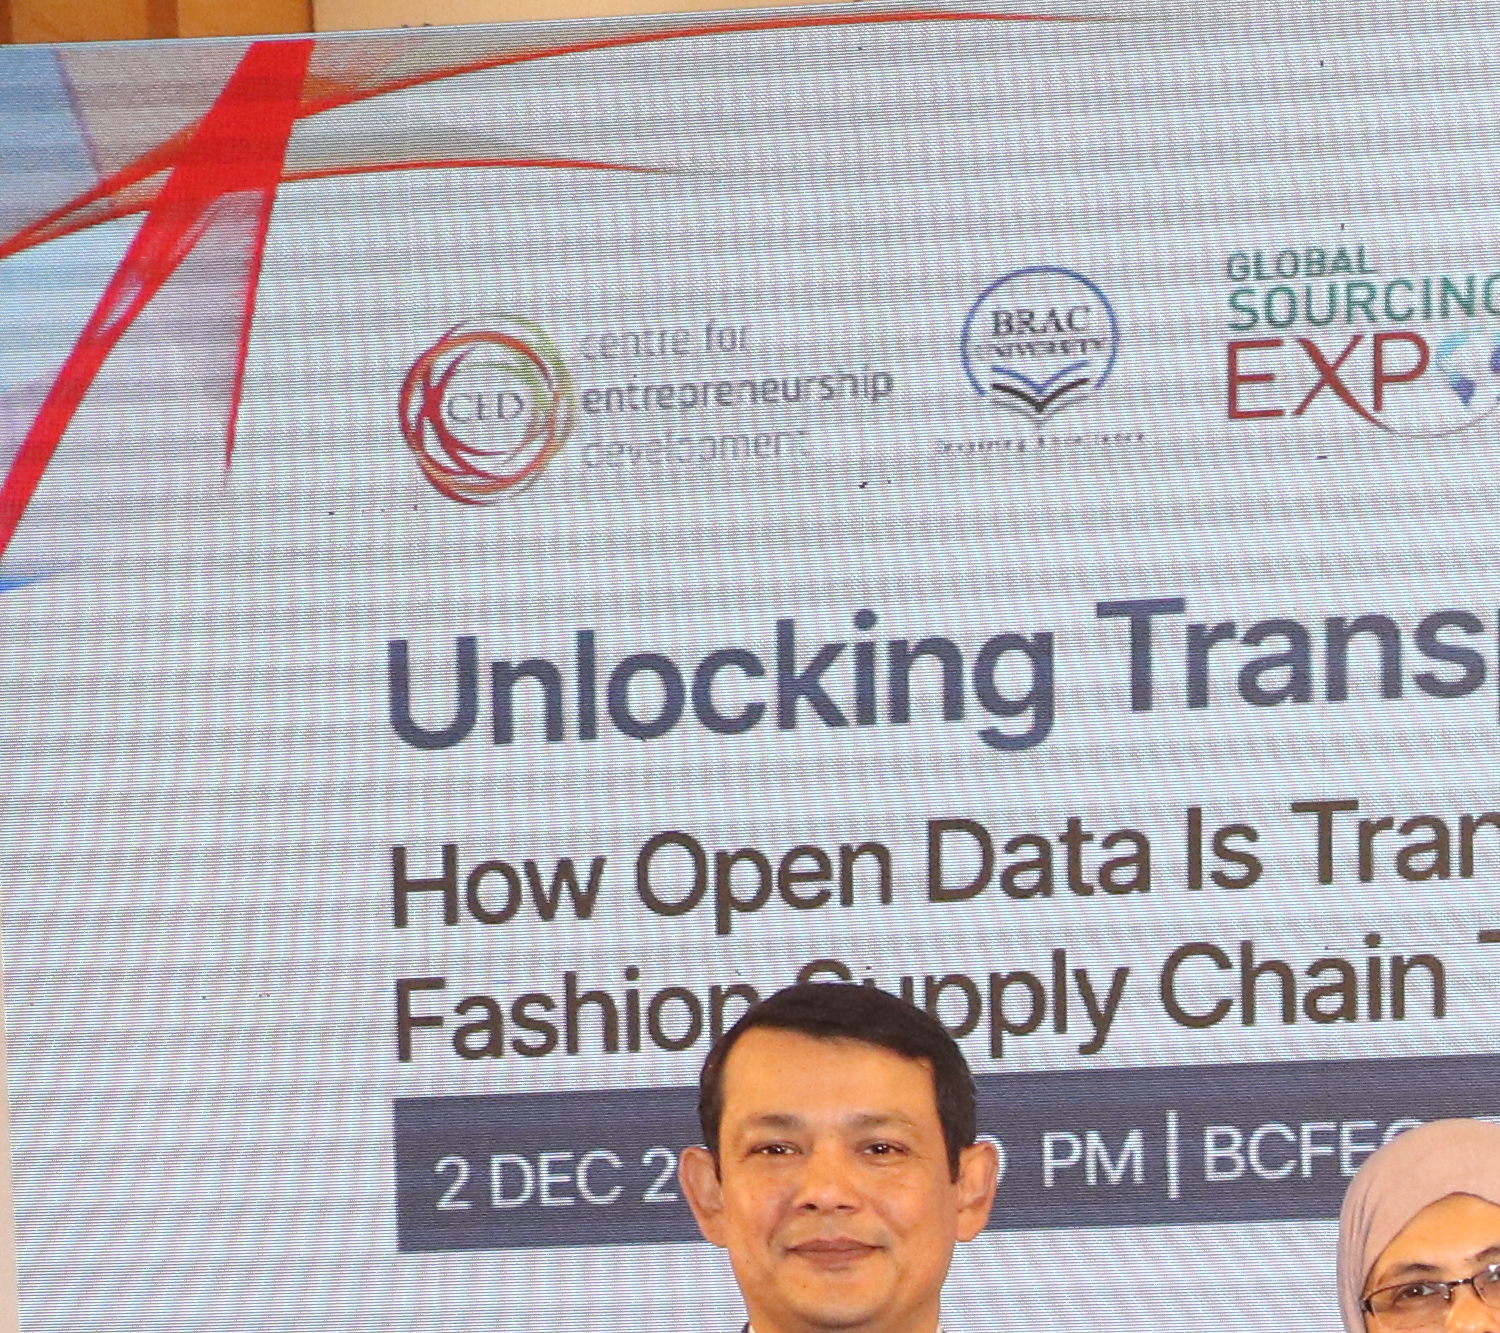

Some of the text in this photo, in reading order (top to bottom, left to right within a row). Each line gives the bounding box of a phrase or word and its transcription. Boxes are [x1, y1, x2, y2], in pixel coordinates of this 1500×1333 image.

[1227, 246, 1379, 281] GLOBAL
[580, 319, 751, 361] centre for
[991, 305, 1091, 336] BRAC
[582, 368, 894, 416] entrepreneurship
[580, 430, 805, 470] development
[386, 608, 1056, 751] Unlocking
[391, 842, 605, 929] How
[635, 829, 893, 937] Open
[926, 816, 1152, 905] Data
[1186, 806, 1263, 891] Is
[1160, 933, 1446, 1029] Chain
[434, 1155, 474, 1211] 2
[489, 1149, 625, 1209] DEC
[1041, 1128, 1145, 1188] PM
[1203, 1118, 1426, 1182] BCFE
